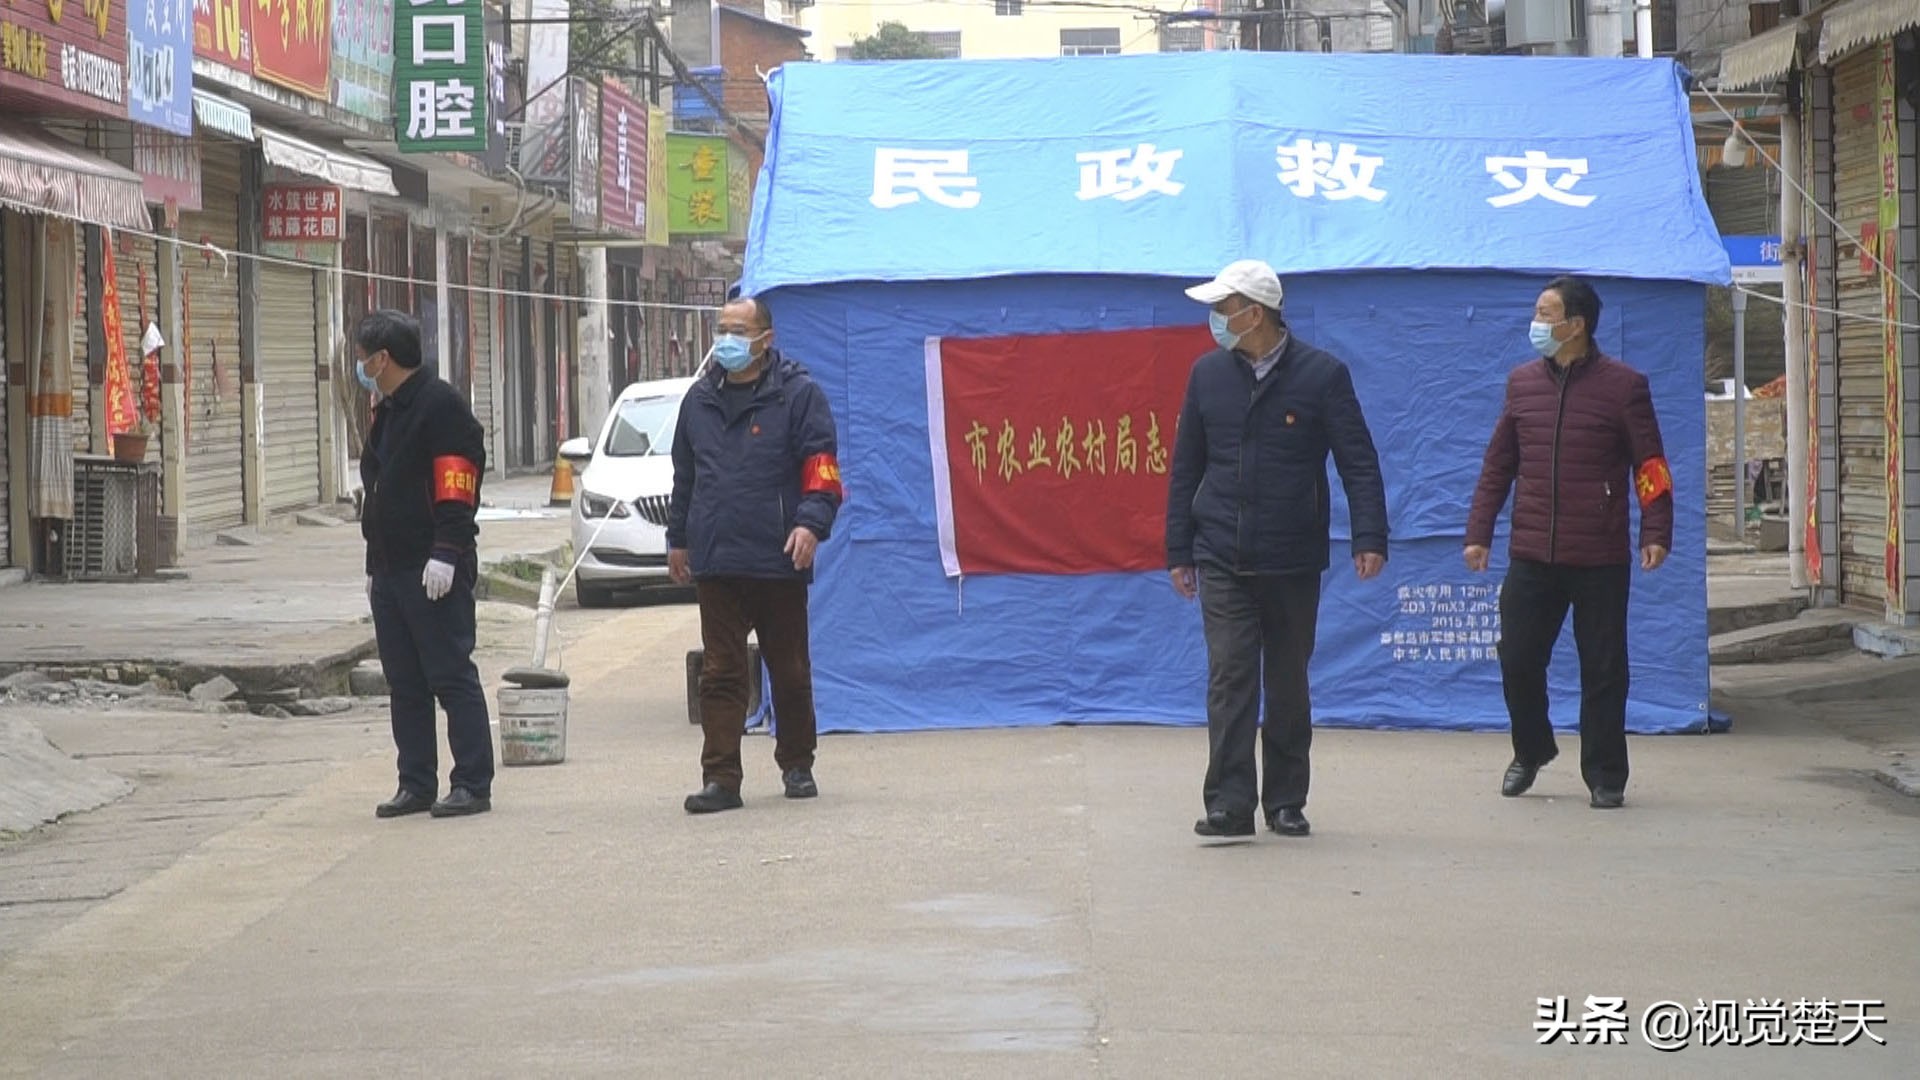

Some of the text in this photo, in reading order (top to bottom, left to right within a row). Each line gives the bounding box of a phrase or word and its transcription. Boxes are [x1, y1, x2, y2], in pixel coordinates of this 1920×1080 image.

[406, 0, 475, 139] 口腔
[868, 138, 1597, 209] 民政救灾
[268, 216, 336, 237] 紫藤花园
[965, 410, 1181, 487] 市农业农村局志
